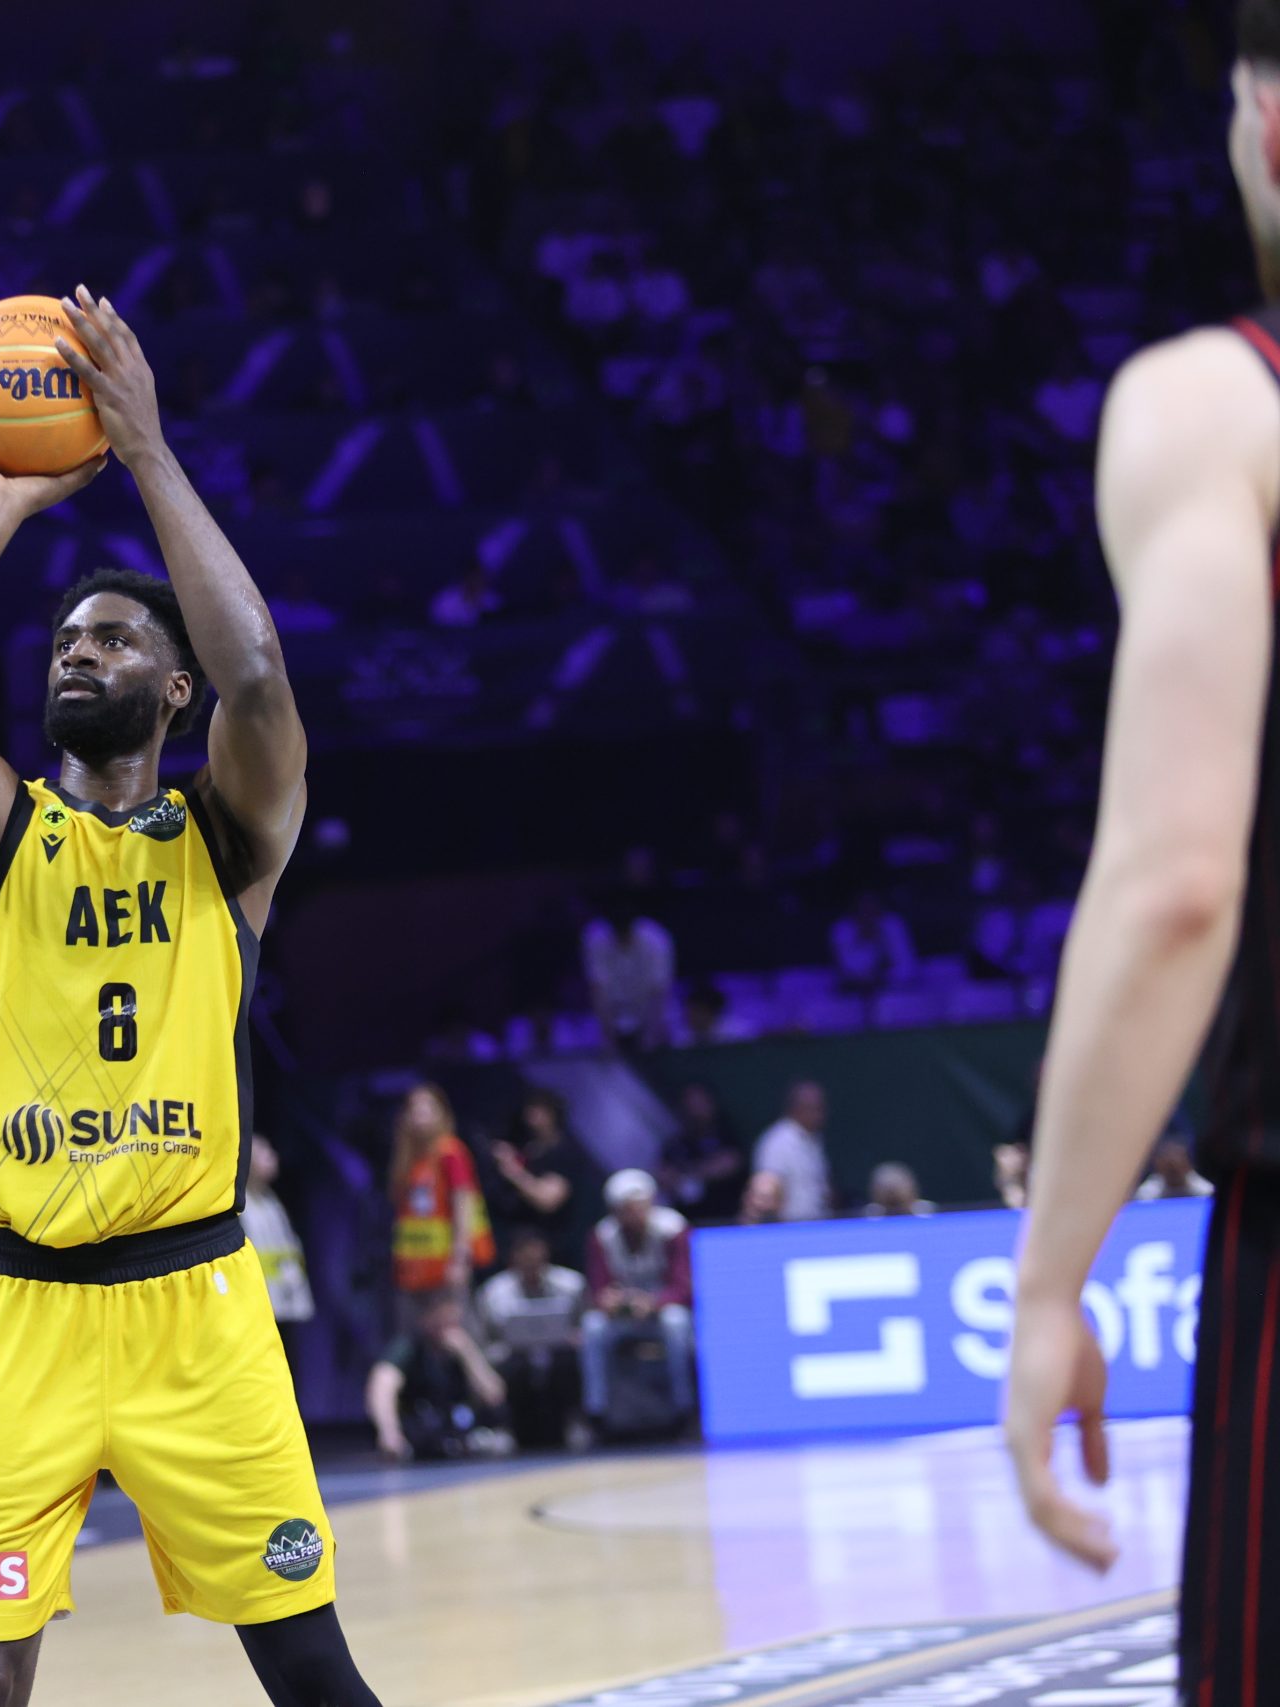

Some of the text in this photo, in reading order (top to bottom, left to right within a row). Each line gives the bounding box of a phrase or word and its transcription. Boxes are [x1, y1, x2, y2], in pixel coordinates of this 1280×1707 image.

[64, 880, 172, 948] AEK
[98, 982, 138, 1062] 8
[69, 1099, 202, 1147] SUNEL
[69, 1139, 159, 1165] Empowering
[265, 1551, 300, 1565] FINAL
[300, 1541, 322, 1557] FOUR
